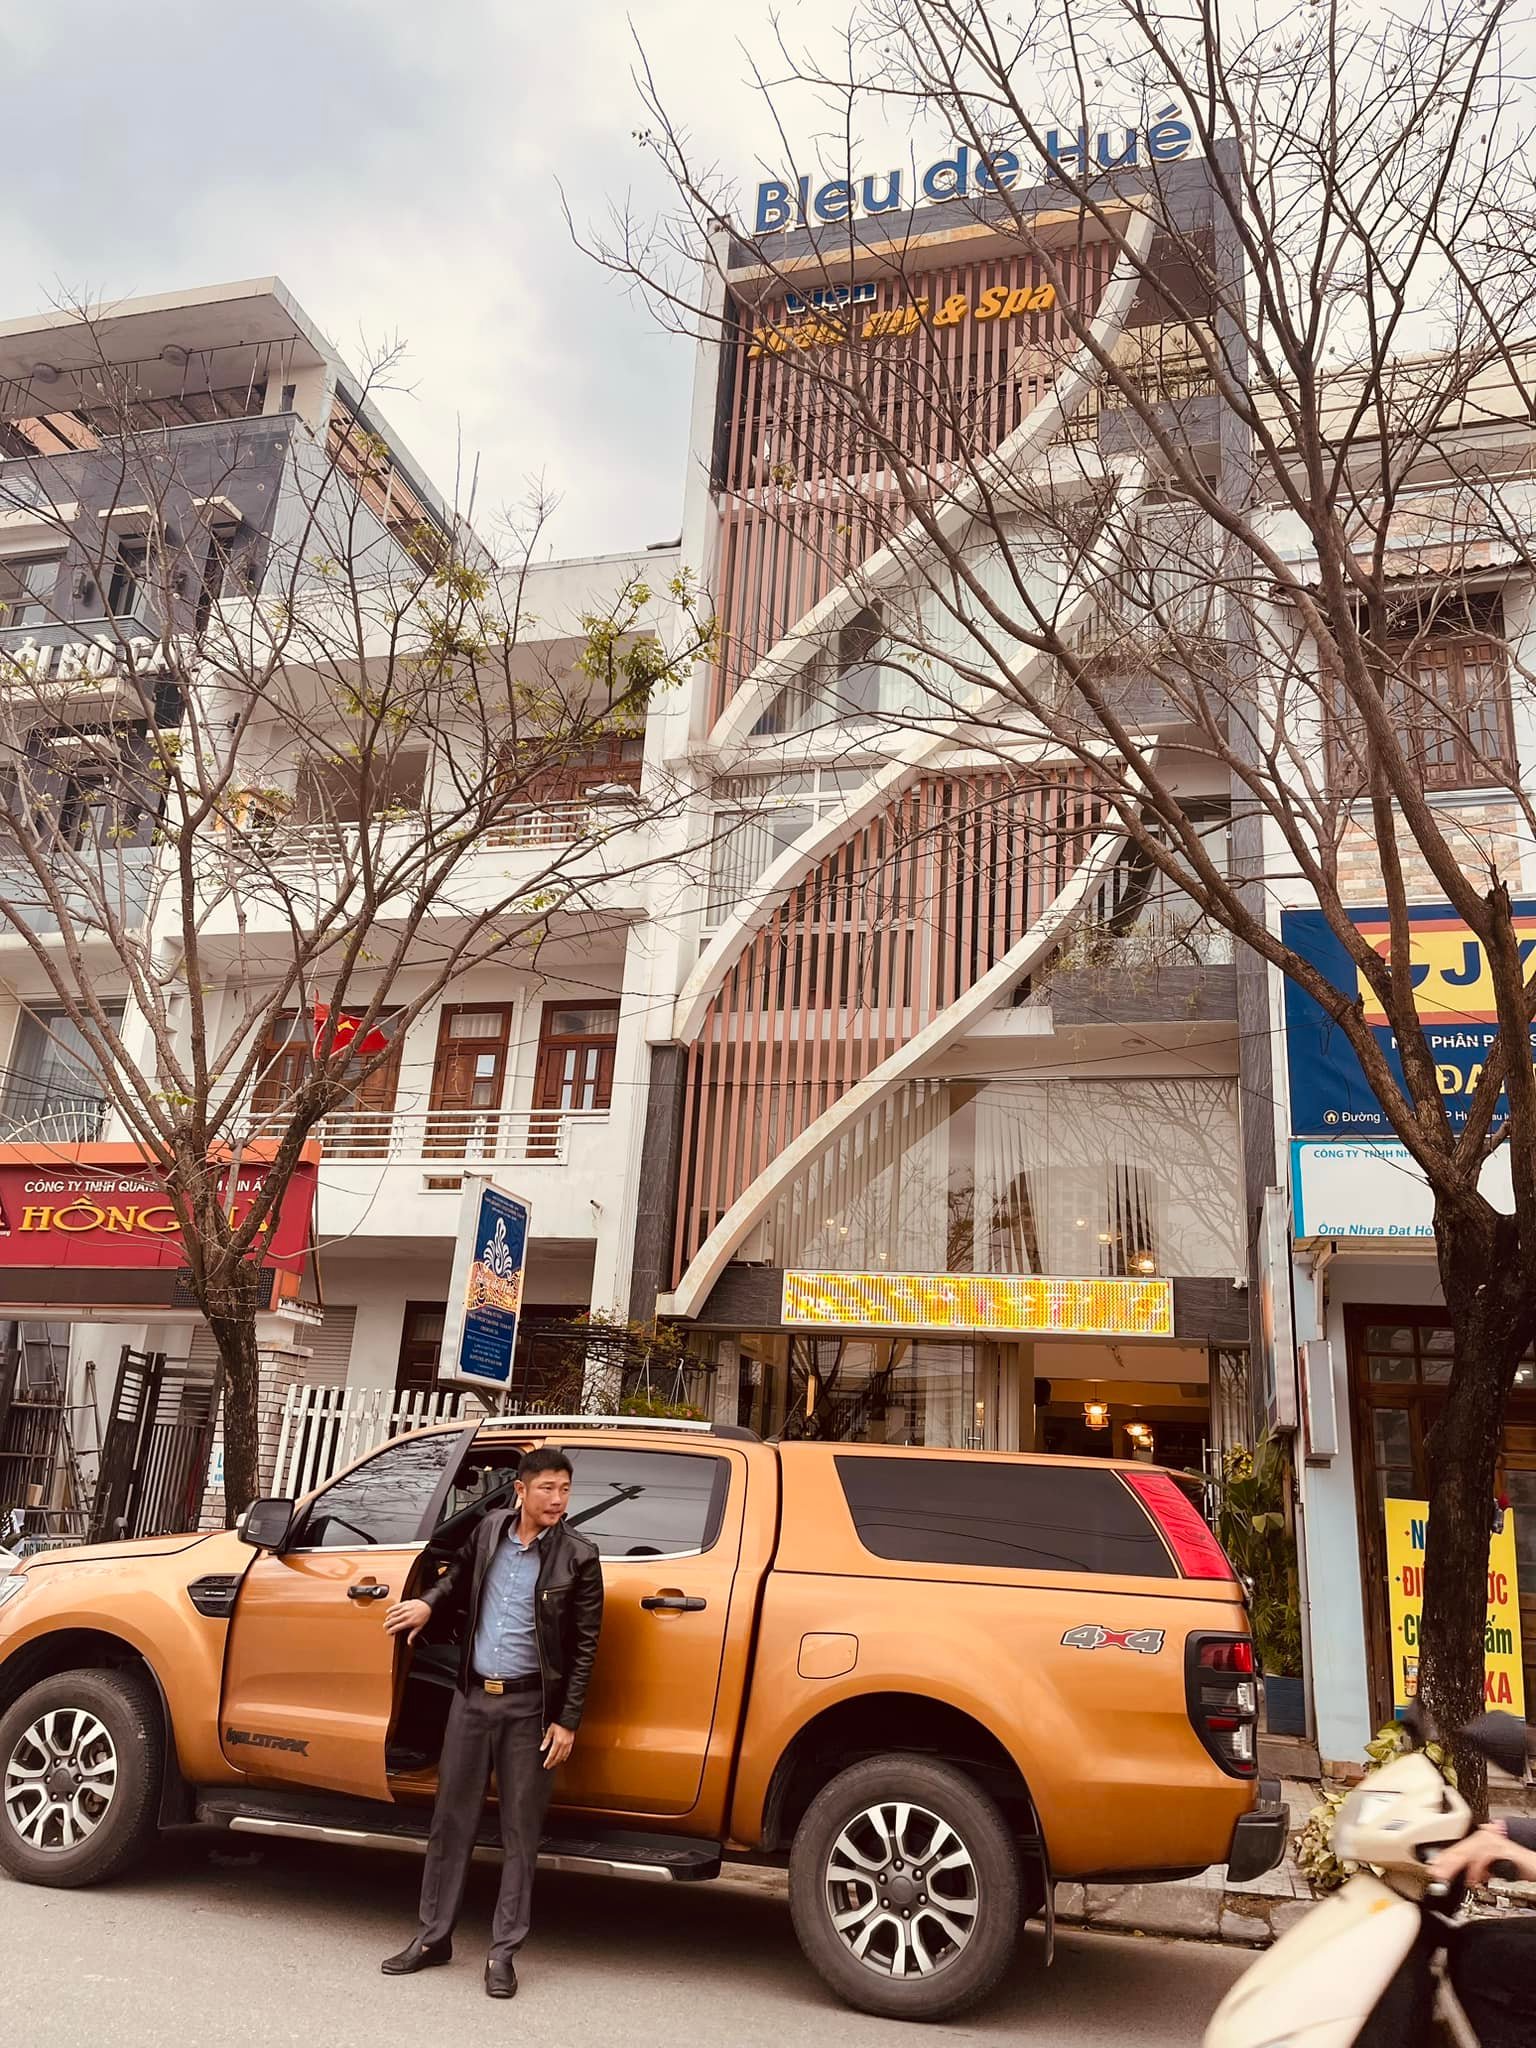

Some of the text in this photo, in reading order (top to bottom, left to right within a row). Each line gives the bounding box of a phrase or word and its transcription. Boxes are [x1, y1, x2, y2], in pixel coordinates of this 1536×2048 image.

[754, 103, 1193, 237] Bleu de Hué
[932, 293, 969, 329] &
[974, 283, 1056, 321] Spa
[1431, 1032, 1479, 1048] PHÂN
[1342, 1110, 1381, 1124] Đường
[1314, 1148, 1343, 1159] CÔNG
[1346, 1149, 1359, 1158] TY
[1364, 1149, 1392, 1158] TNHH
[24, 1178, 65, 1193] CÔNG
[67, 1180, 82, 1192] TY
[85, 1180, 116, 1192] TNHH
